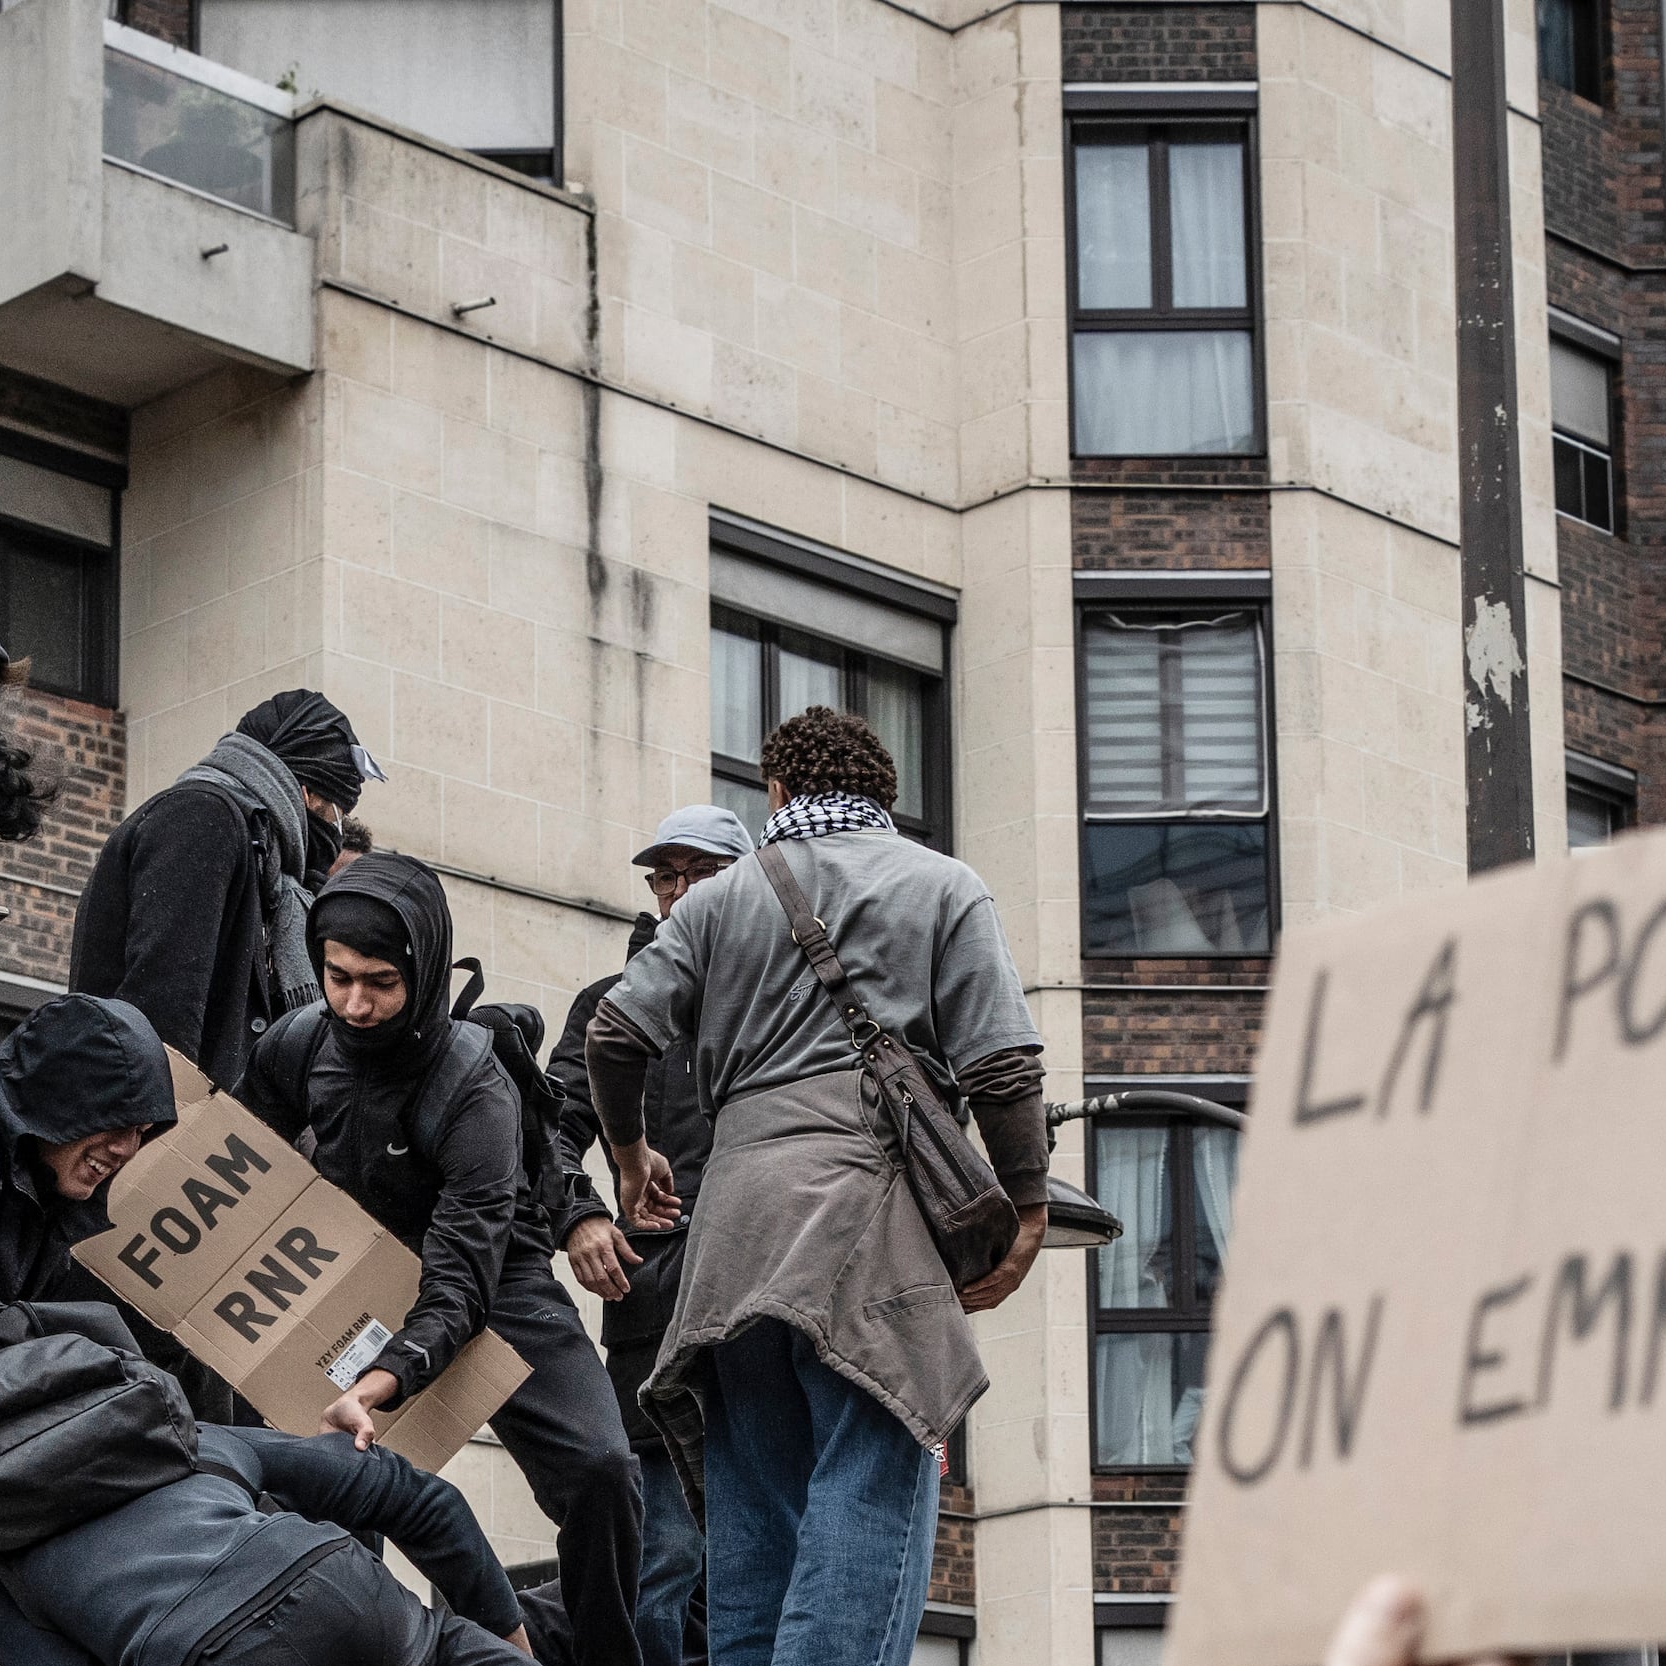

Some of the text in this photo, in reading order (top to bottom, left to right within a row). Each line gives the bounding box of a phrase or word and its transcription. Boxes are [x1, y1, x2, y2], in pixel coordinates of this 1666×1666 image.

[1288, 939, 1458, 1128] LA
[118, 1133, 272, 1290] FOAM
[213, 1226, 340, 1344] RNR
[315, 1350, 334, 1368] YZY
[332, 1329, 356, 1353] FOAM
[352, 1312, 372, 1332] RNR
[1215, 1291, 1386, 1489] ON
